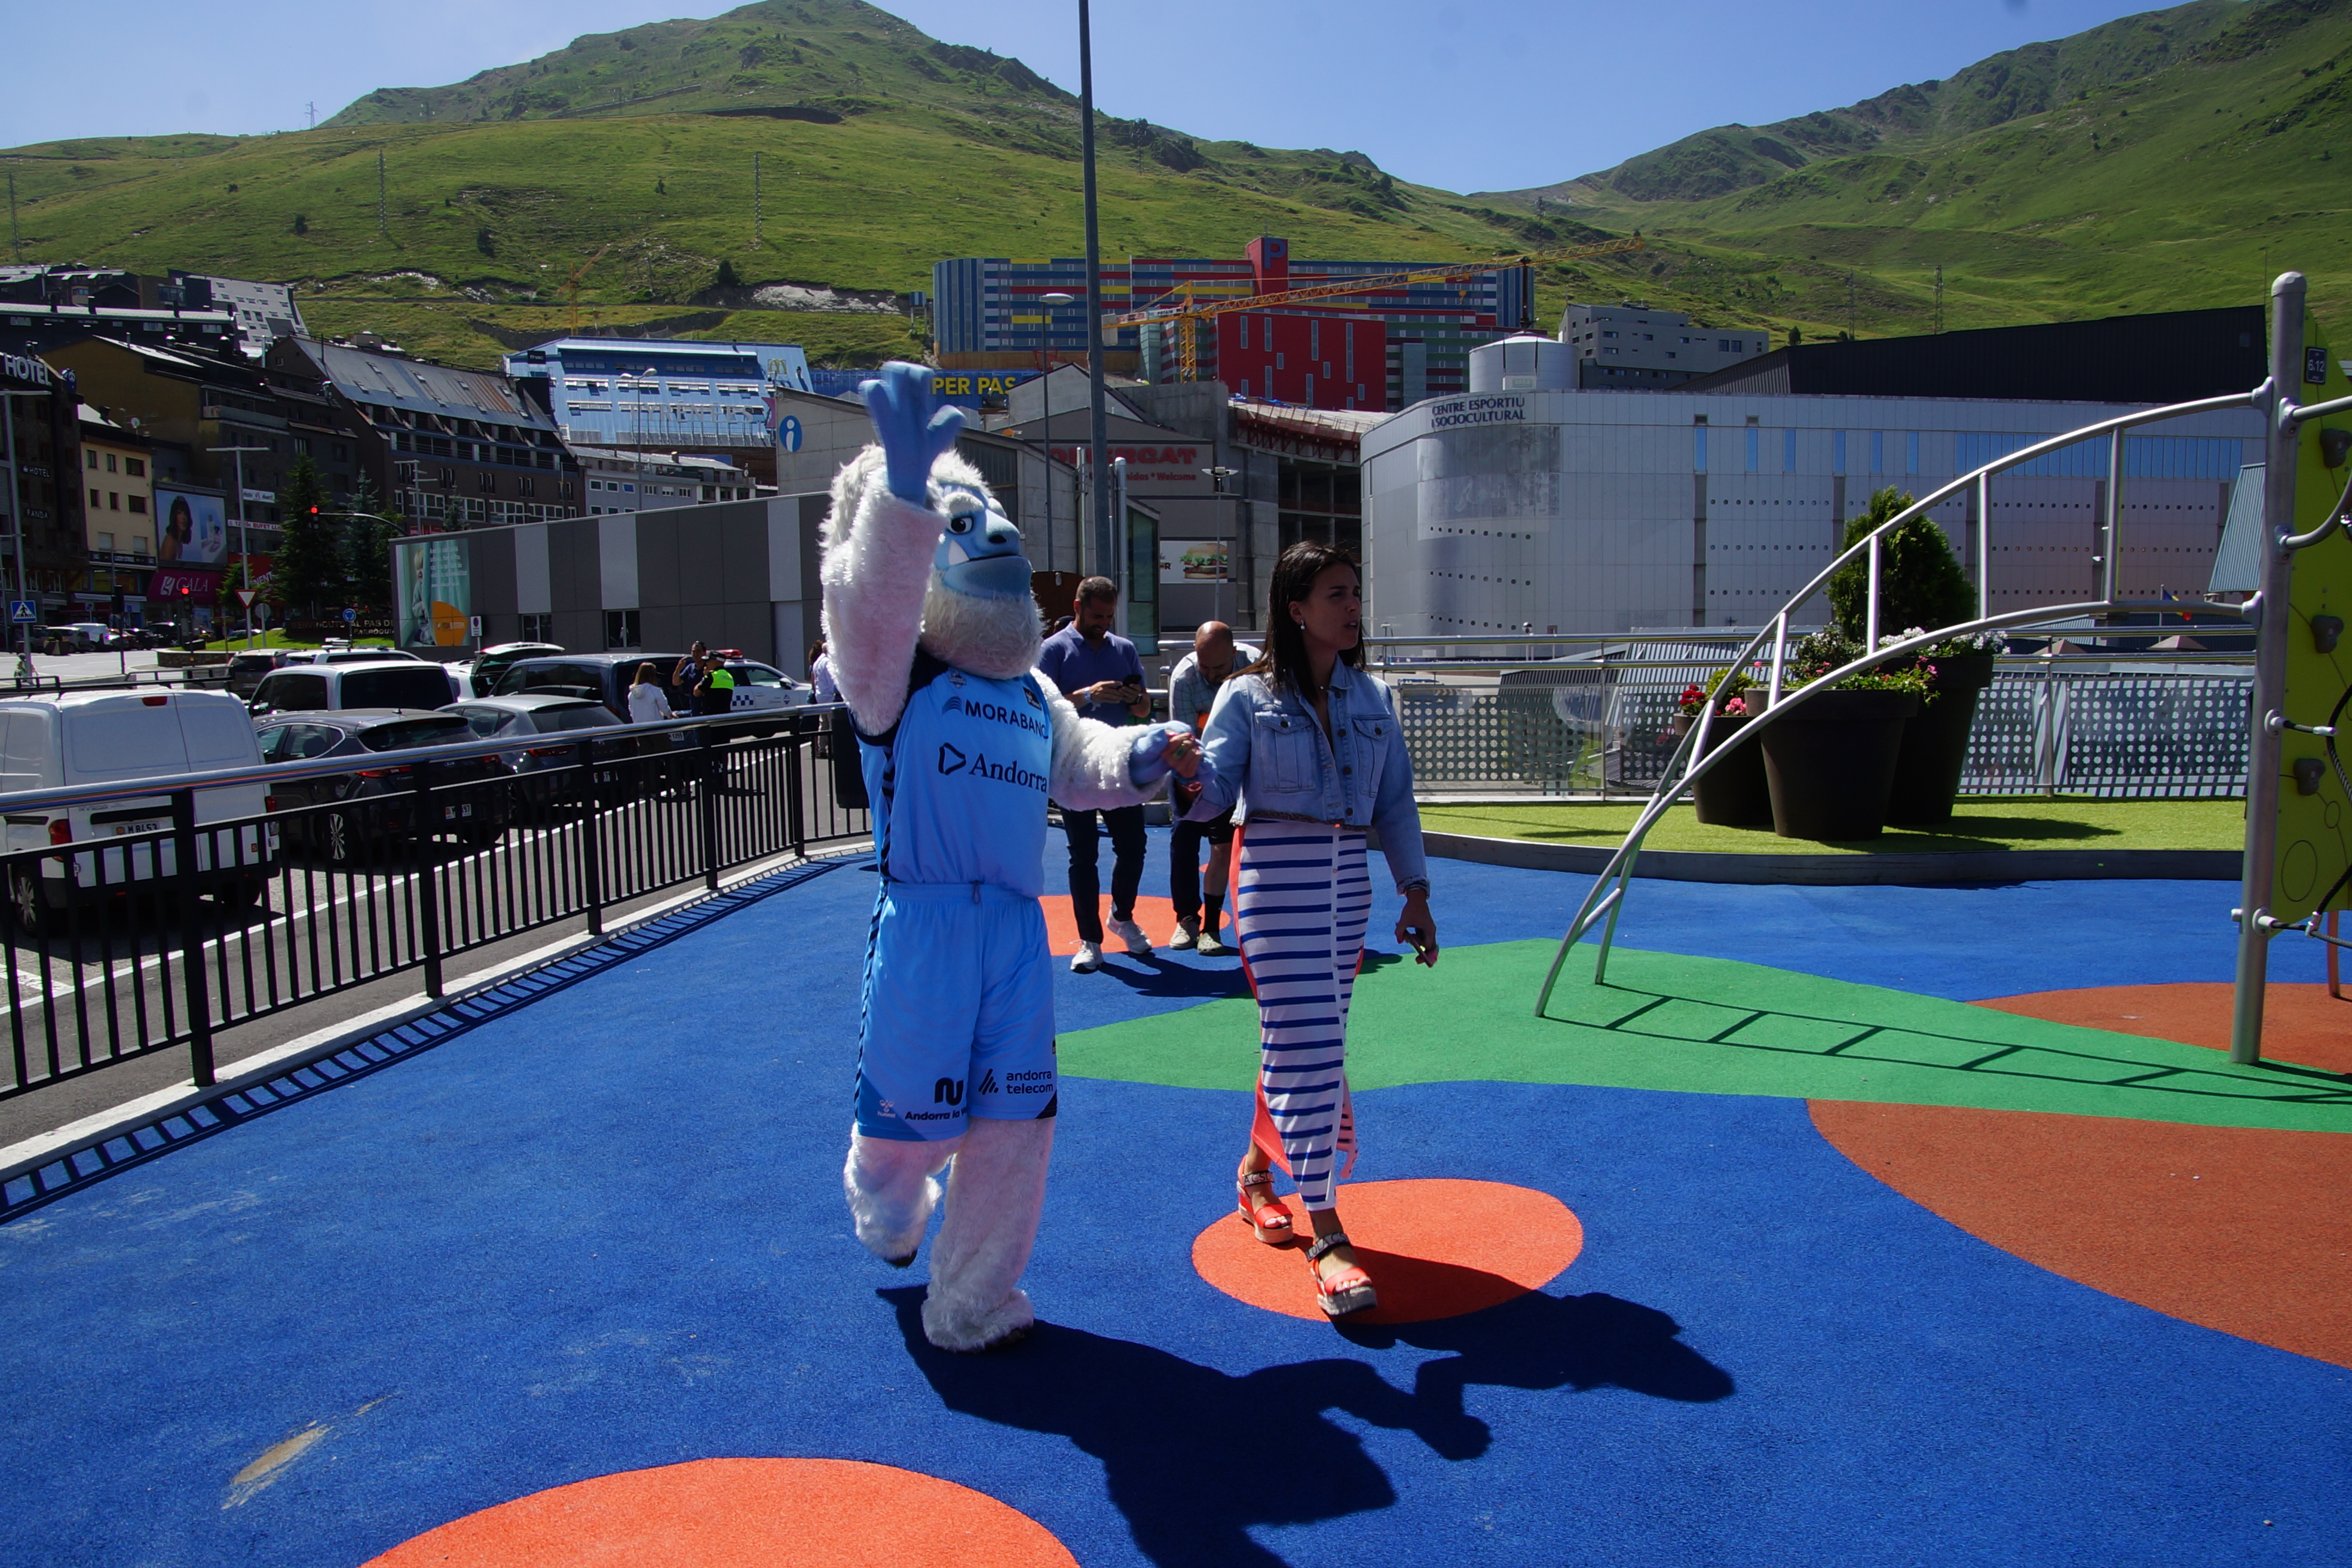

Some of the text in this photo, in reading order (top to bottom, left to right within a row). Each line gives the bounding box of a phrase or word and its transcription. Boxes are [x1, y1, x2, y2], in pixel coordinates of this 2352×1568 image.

[1264, 238, 1286, 269] P
[5, 354, 52, 386] HOTEL
[1432, 397, 1524, 415] CENTRE ESPORTIU
[1436, 410, 1526, 427] SOCIOCULTURAL
[29, 467, 50, 477] HOTEL
[1156, 472, 1194, 480] Welcome
[176, 577, 208, 592] GALA
[968, 753, 1047, 794] Andorra
[1006, 1070, 1052, 1081] andorra
[1006, 1083, 1054, 1094] telecom
[905, 1111, 951, 1121] Andorra
[952, 1110, 961, 1119] la
